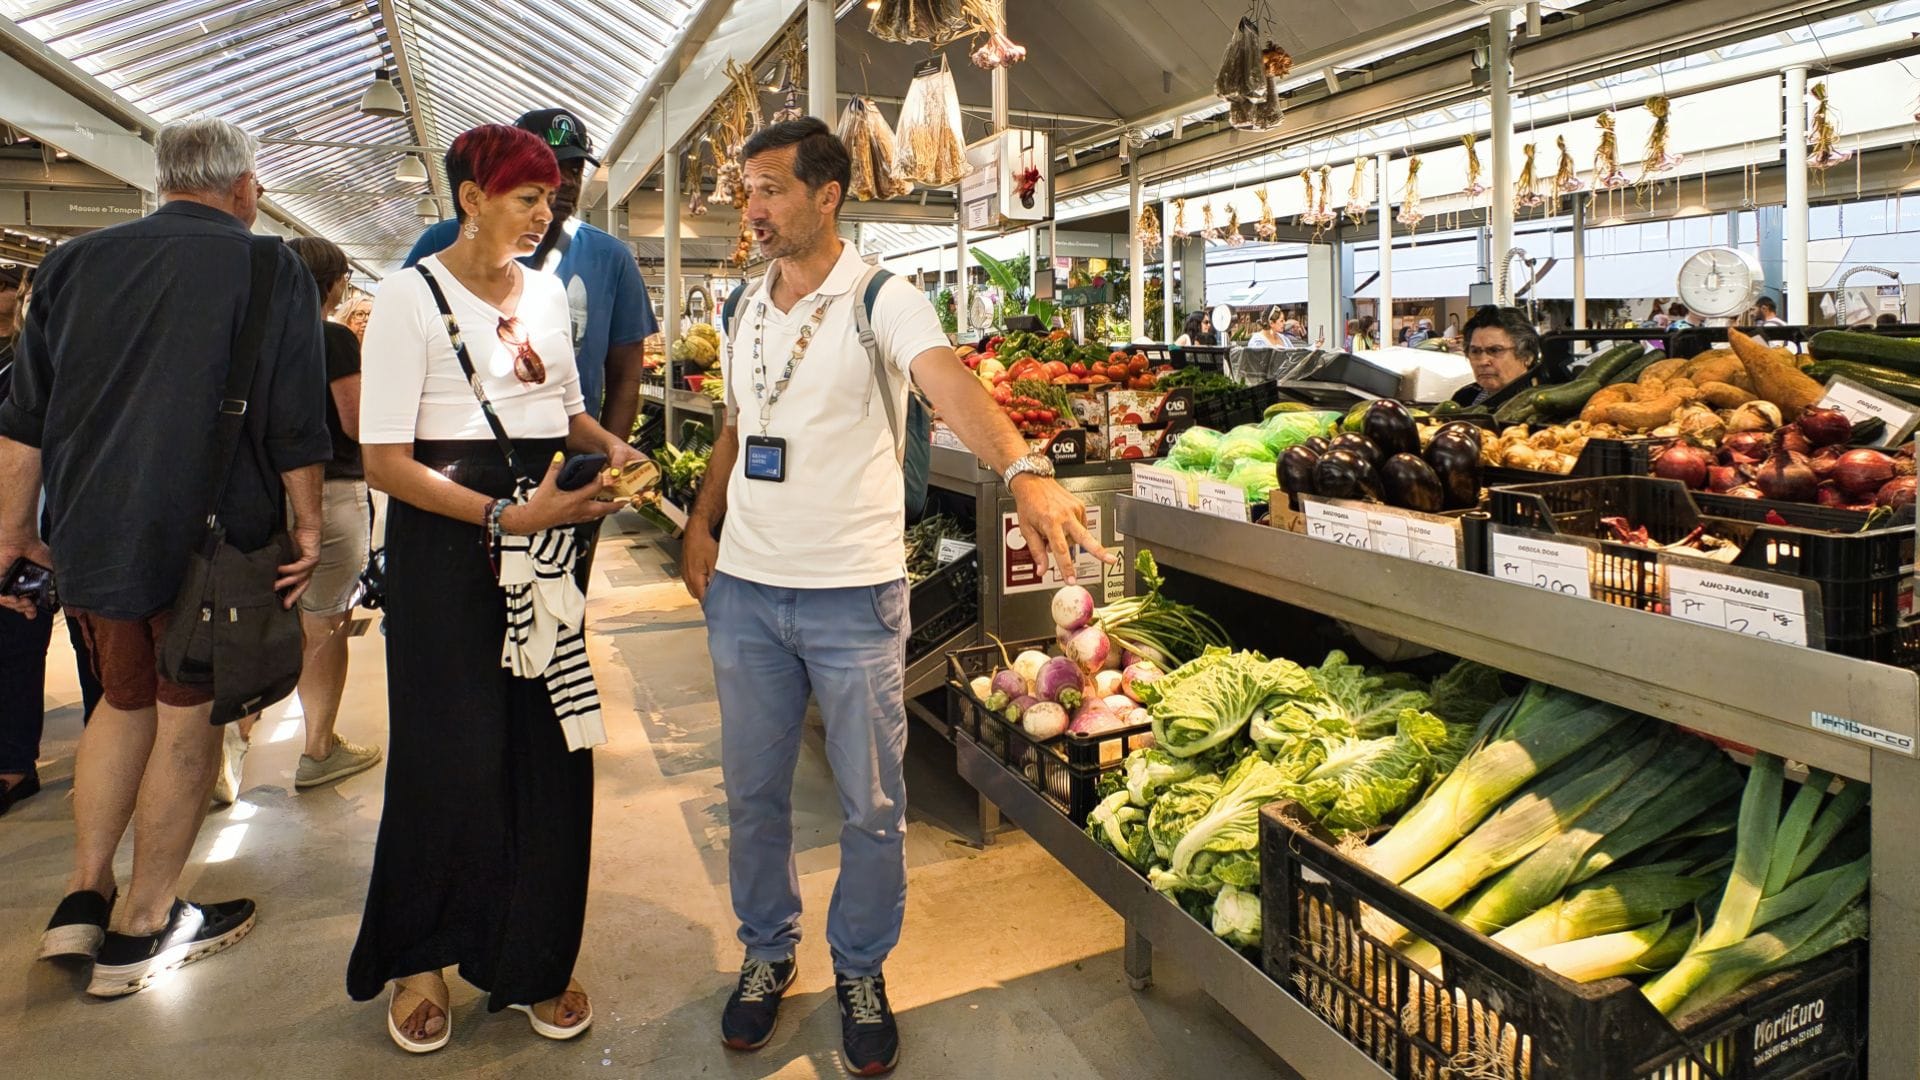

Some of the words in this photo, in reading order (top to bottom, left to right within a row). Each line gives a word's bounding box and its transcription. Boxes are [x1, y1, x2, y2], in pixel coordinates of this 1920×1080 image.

[1165, 400, 1185, 412] CASI
[1052, 441, 1075, 454] CASI
[1312, 522, 1326, 536] PT
[1503, 562, 1520, 575] PT
[1681, 598, 1706, 615] PT
[1821, 718, 1911, 748] Fribarco
